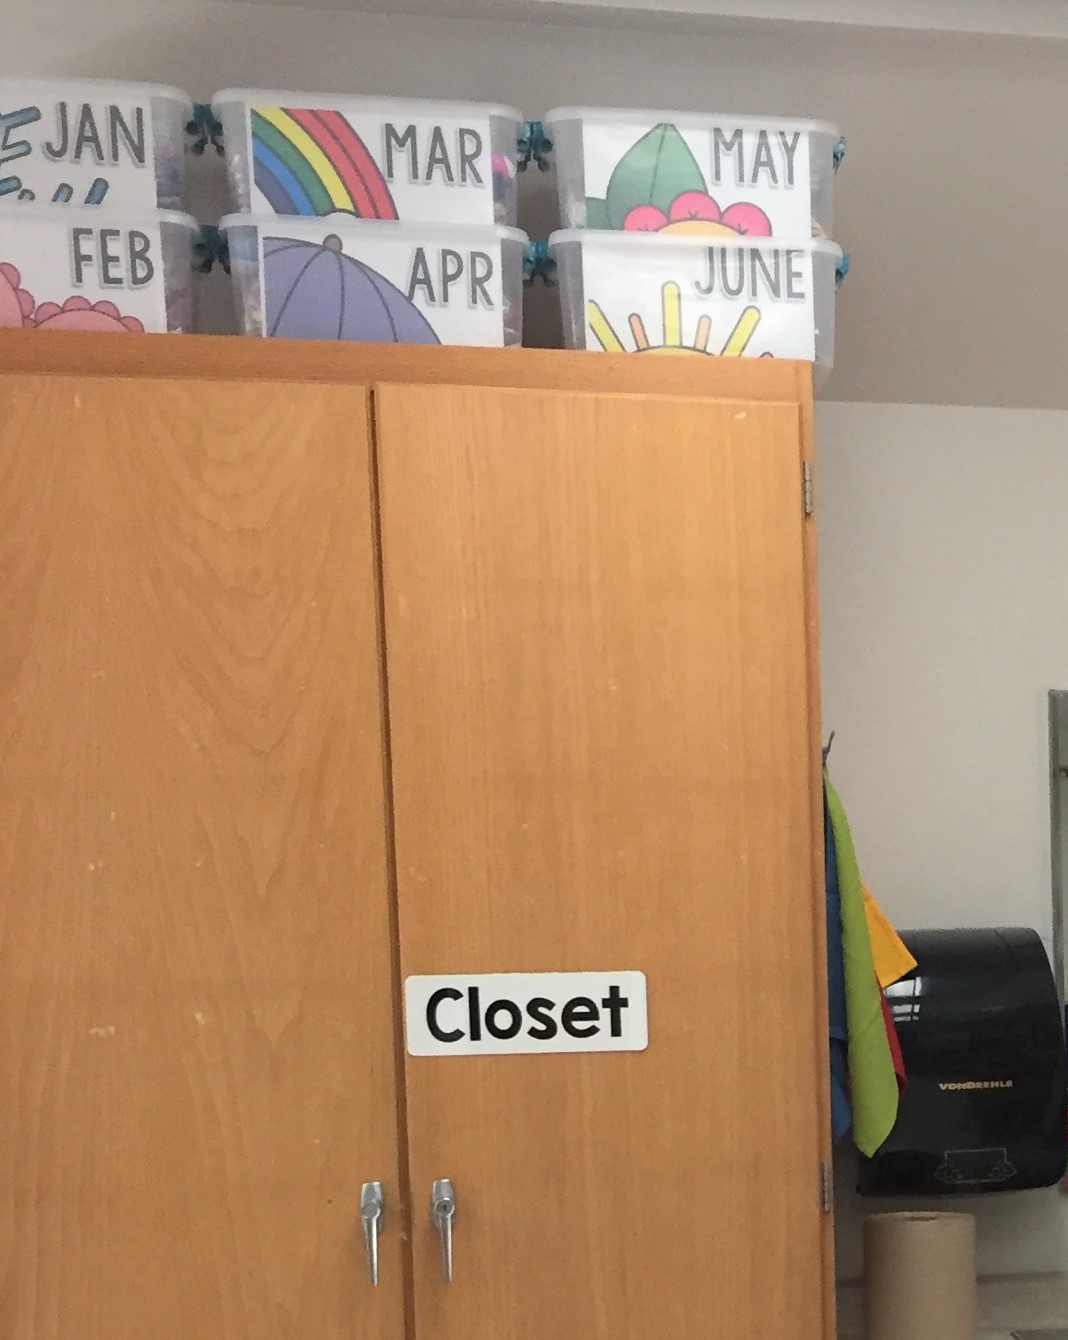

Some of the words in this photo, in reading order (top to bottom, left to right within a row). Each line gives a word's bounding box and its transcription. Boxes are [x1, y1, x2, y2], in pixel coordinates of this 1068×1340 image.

[45, 101, 146, 164] JAN
[384, 122, 484, 185] MAR
[713, 127, 800, 186] MAY
[72, 227, 155, 286] FEB
[406, 247, 494, 306] APR
[694, 246, 806, 299] JUNE
[426, 985, 629, 1043] Closet
